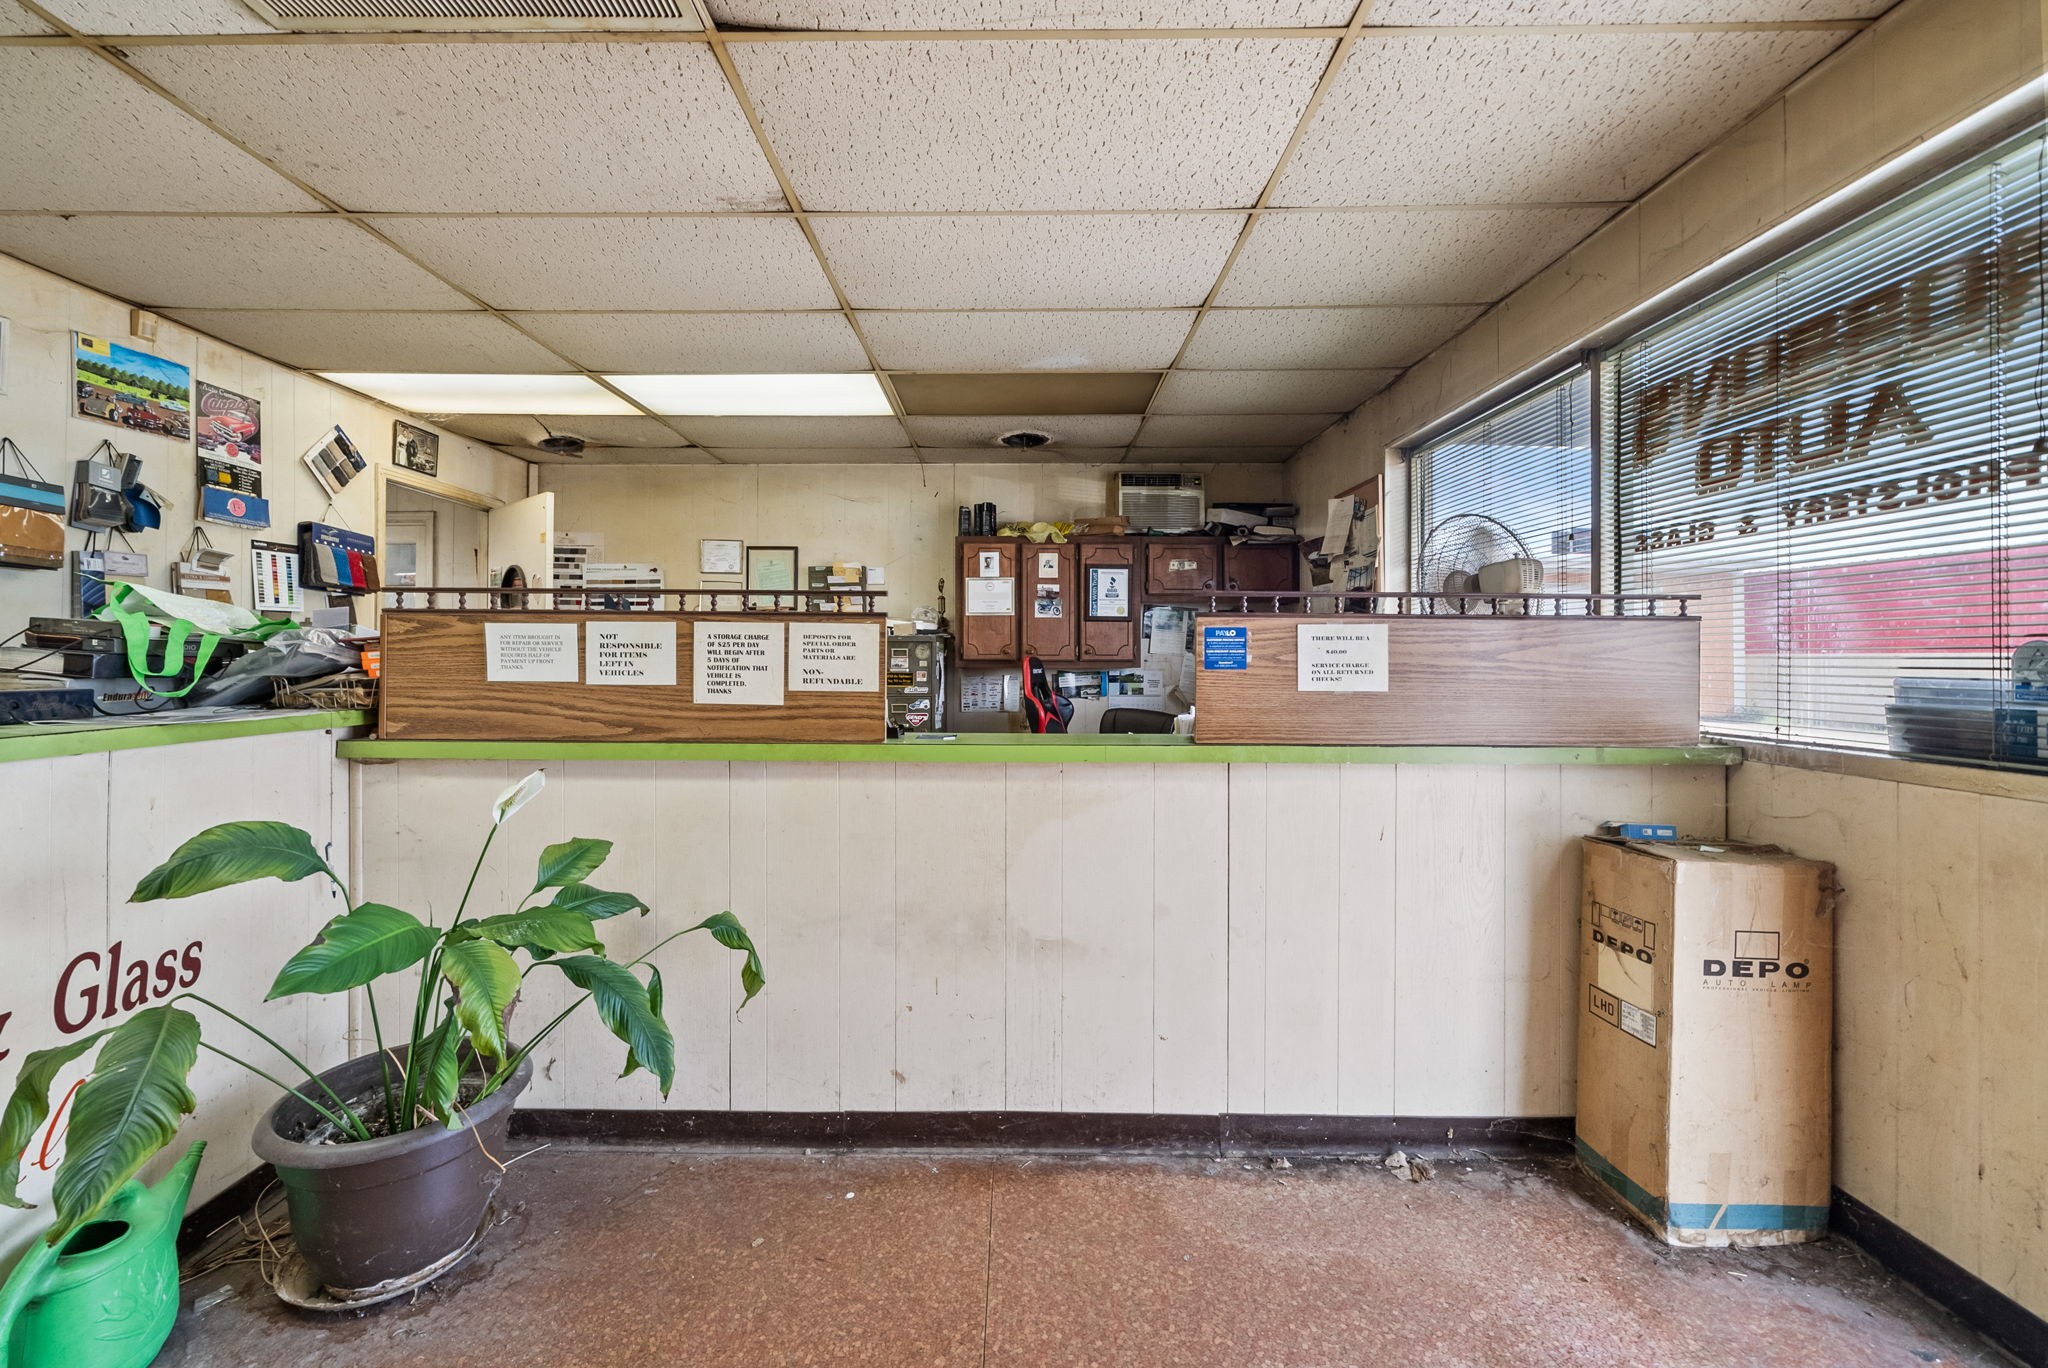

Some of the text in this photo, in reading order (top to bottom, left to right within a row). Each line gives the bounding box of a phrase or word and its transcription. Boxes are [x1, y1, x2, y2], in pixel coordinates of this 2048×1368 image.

[1592, 929, 1653, 964] DEPO
[1703, 959, 1810, 979] DEPO
[54, 940, 203, 1034] Glass
[1594, 994, 1614, 1016] LHD
